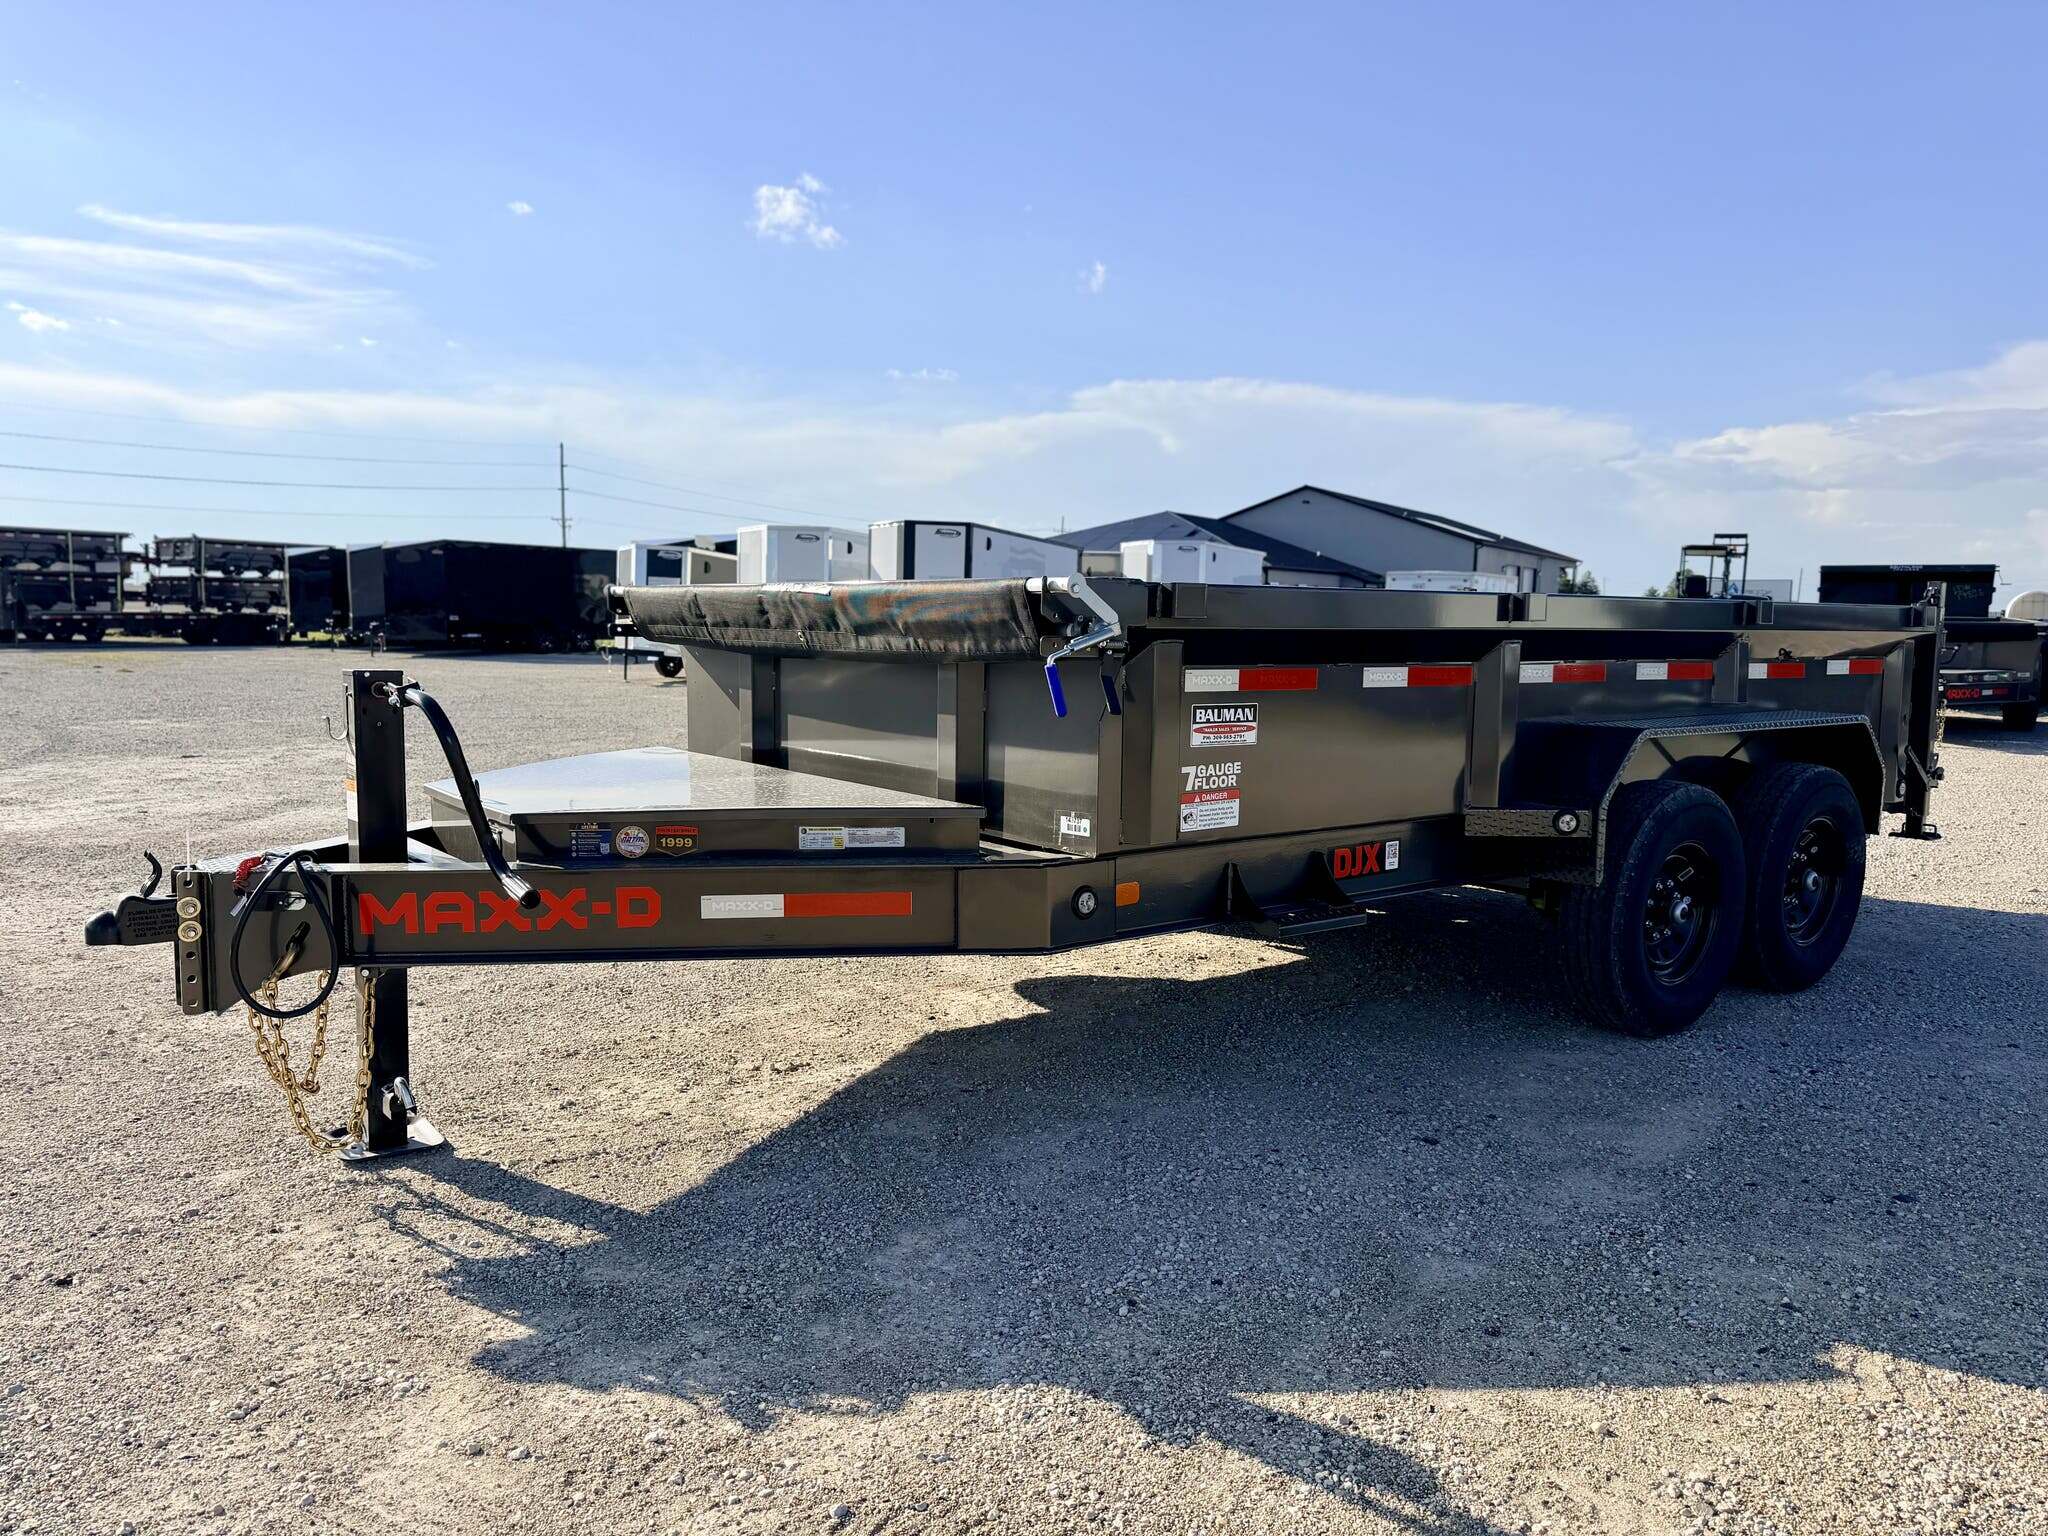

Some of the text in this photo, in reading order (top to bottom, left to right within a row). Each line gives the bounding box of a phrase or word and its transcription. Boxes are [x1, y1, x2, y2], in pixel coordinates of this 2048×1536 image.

[1192, 675, 1233, 685] MAXX-D
[1196, 708, 1254, 722] BAUMAN
[1181, 761, 1241, 791] 7 GAUGE
[1194, 775, 1237, 790] FLOOR
[1201, 792, 1228, 801] DANGER
[660, 837, 693, 847] 1999
[1334, 843, 1380, 878] DJX
[360, 887, 661, 934] MAXX-D
[711, 901, 774, 912] MAXX-D
